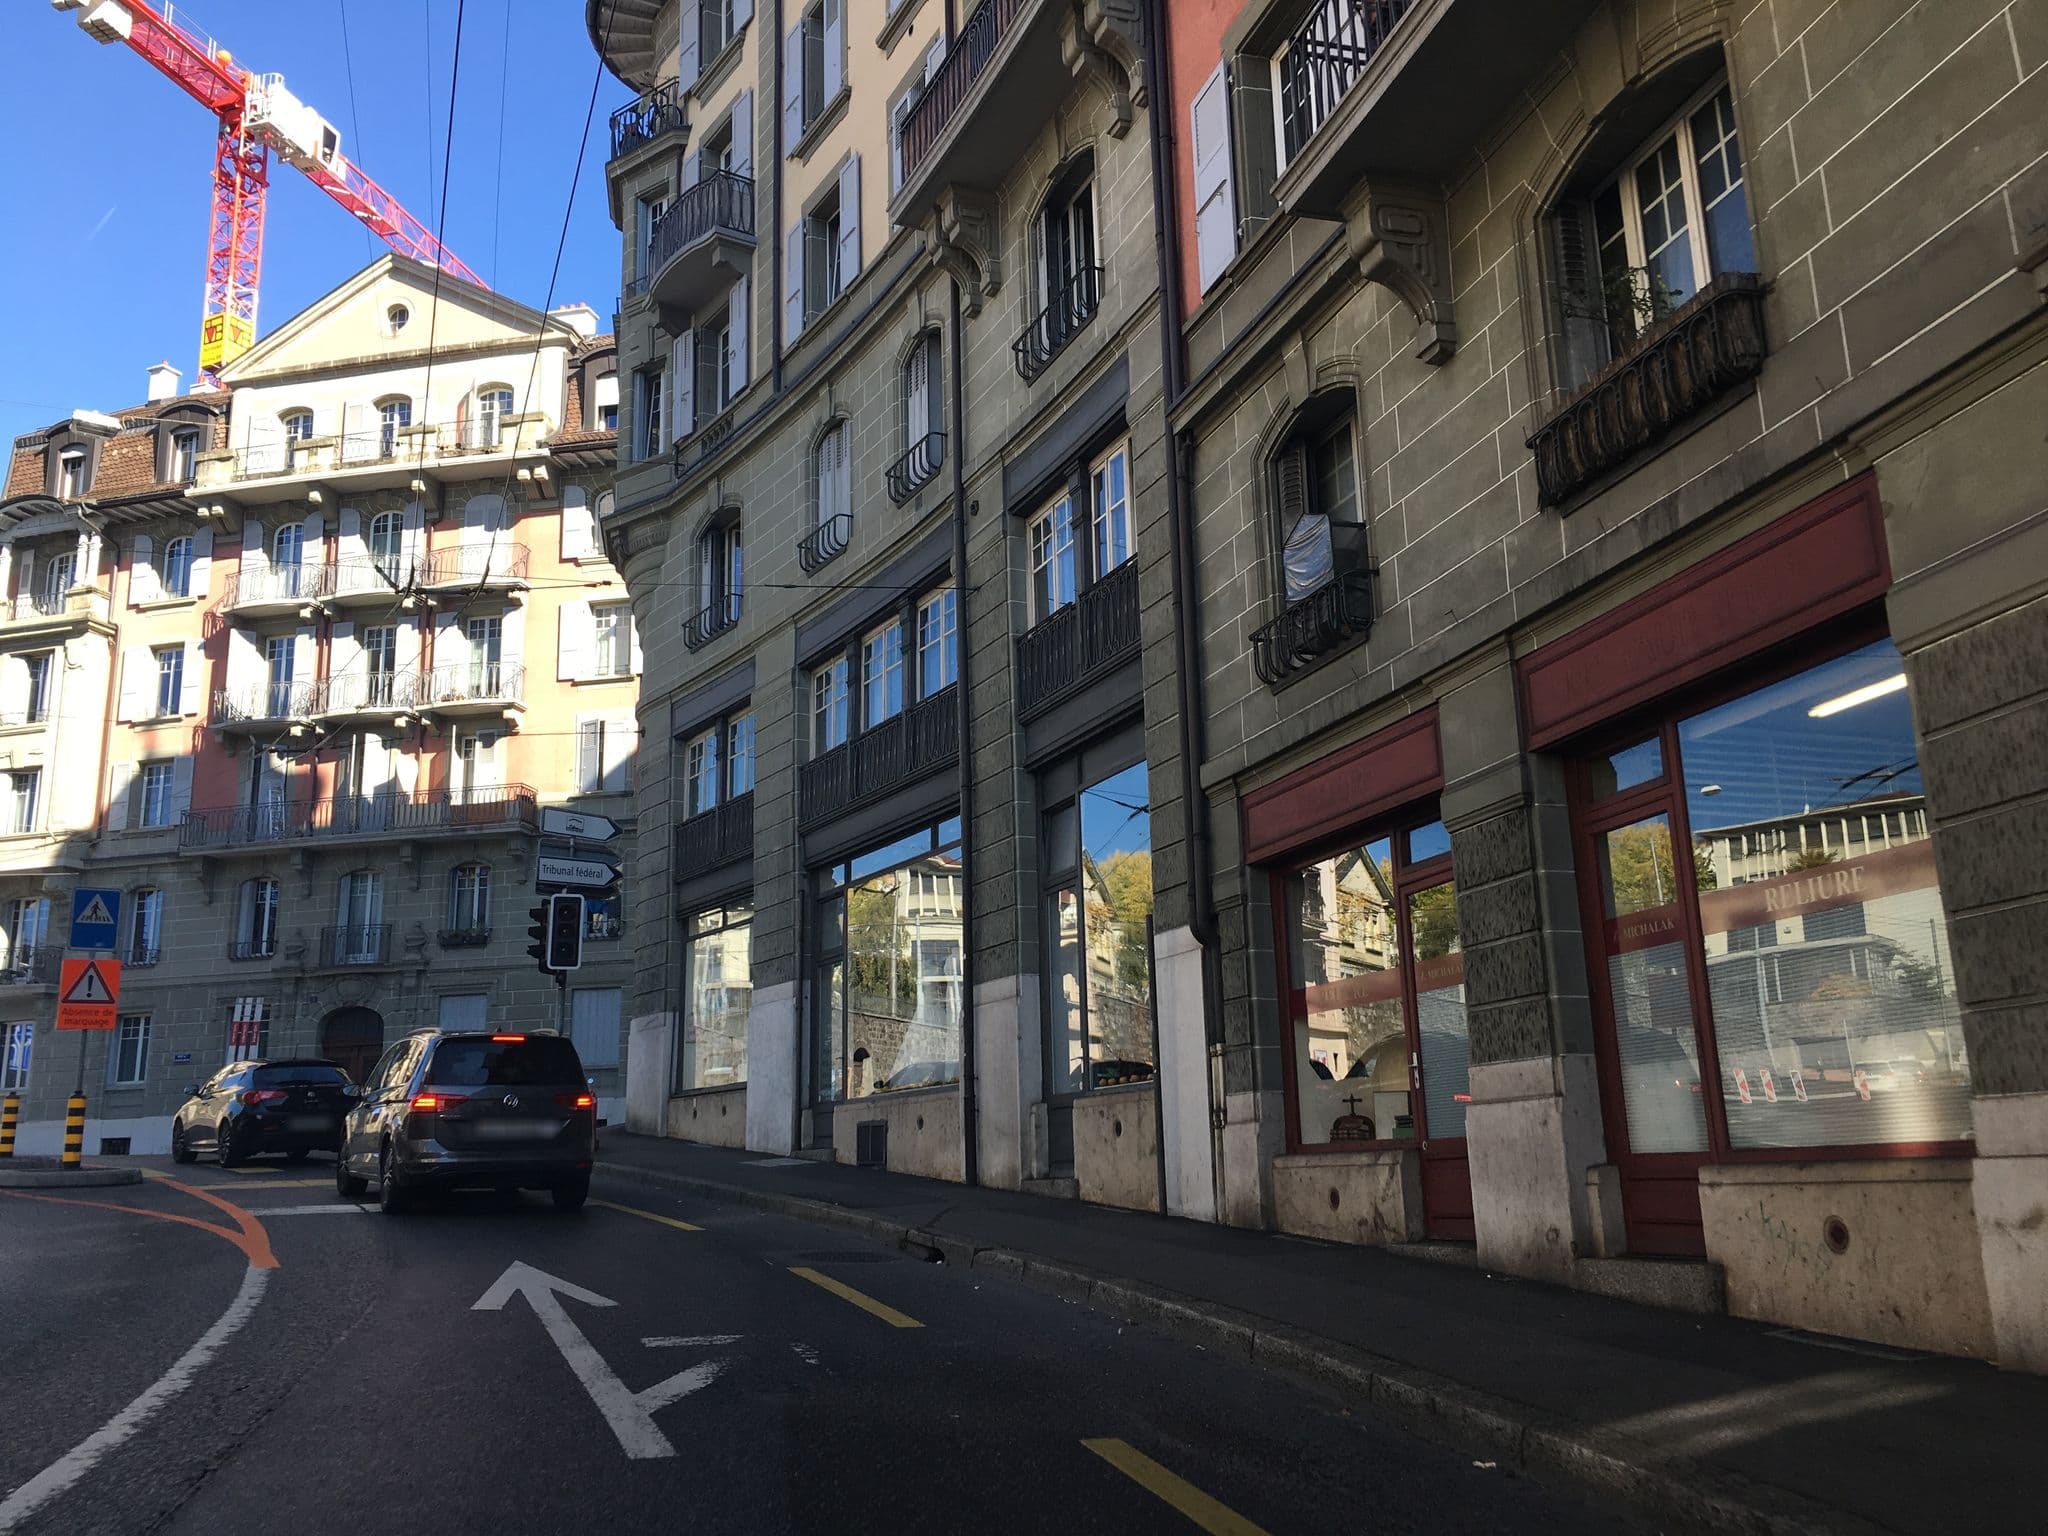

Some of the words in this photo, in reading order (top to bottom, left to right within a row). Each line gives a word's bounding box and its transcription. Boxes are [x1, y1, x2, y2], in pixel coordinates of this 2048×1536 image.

[542, 864, 574, 877] Tribunal
[575, 866, 604, 879] fédéral
[1764, 865, 1866, 913] RELIURE
[1623, 917, 1675, 939] MICHALAK
[102, 1008, 113, 1017] de
